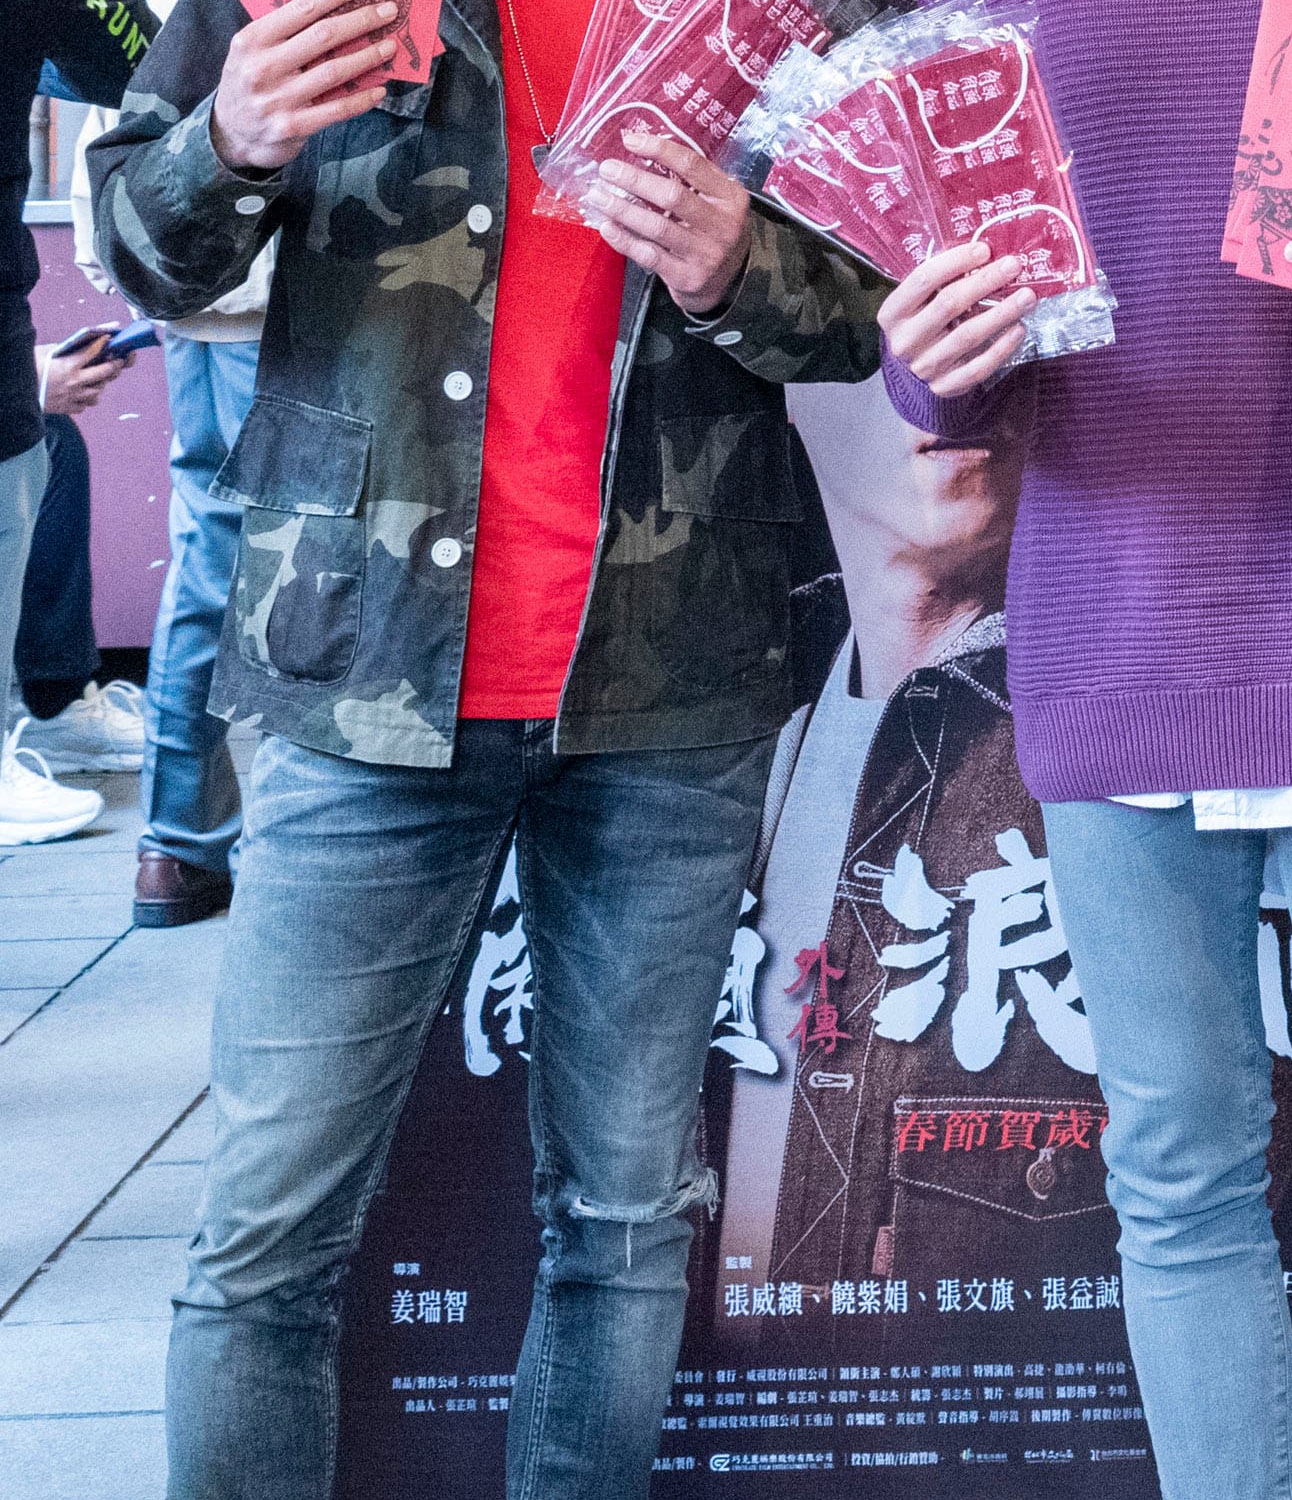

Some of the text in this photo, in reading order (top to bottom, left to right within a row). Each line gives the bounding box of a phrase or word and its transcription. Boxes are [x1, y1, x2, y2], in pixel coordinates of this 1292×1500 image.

[894, 1108, 1108, 1154] 春節賀歲
[390, 1288, 469, 1325] 姜瑞智
